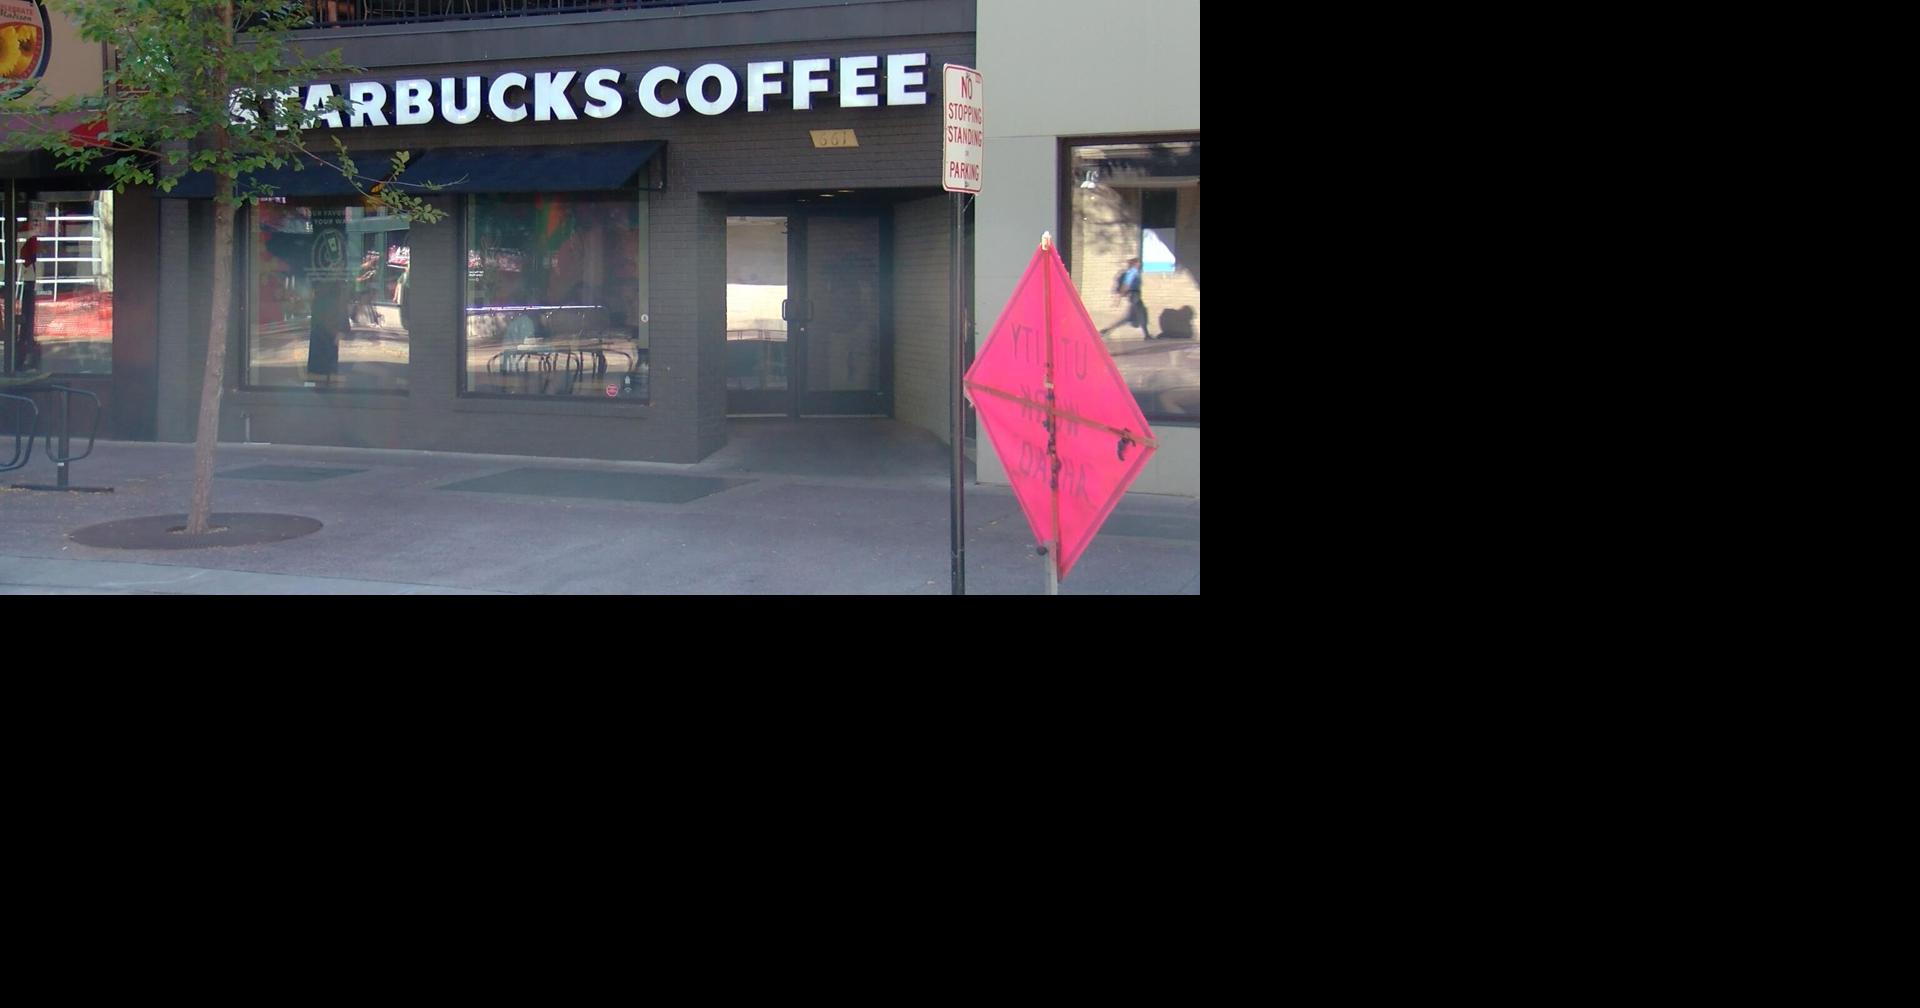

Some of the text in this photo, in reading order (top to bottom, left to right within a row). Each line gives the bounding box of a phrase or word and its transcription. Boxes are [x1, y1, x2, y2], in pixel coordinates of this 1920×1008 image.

[635, 53, 926, 118] COFFEE
[961, 76, 973, 99] NO
[948, 102, 982, 124] STOPPING
[947, 125, 982, 147] STANDING
[949, 161, 979, 181] PARKING
